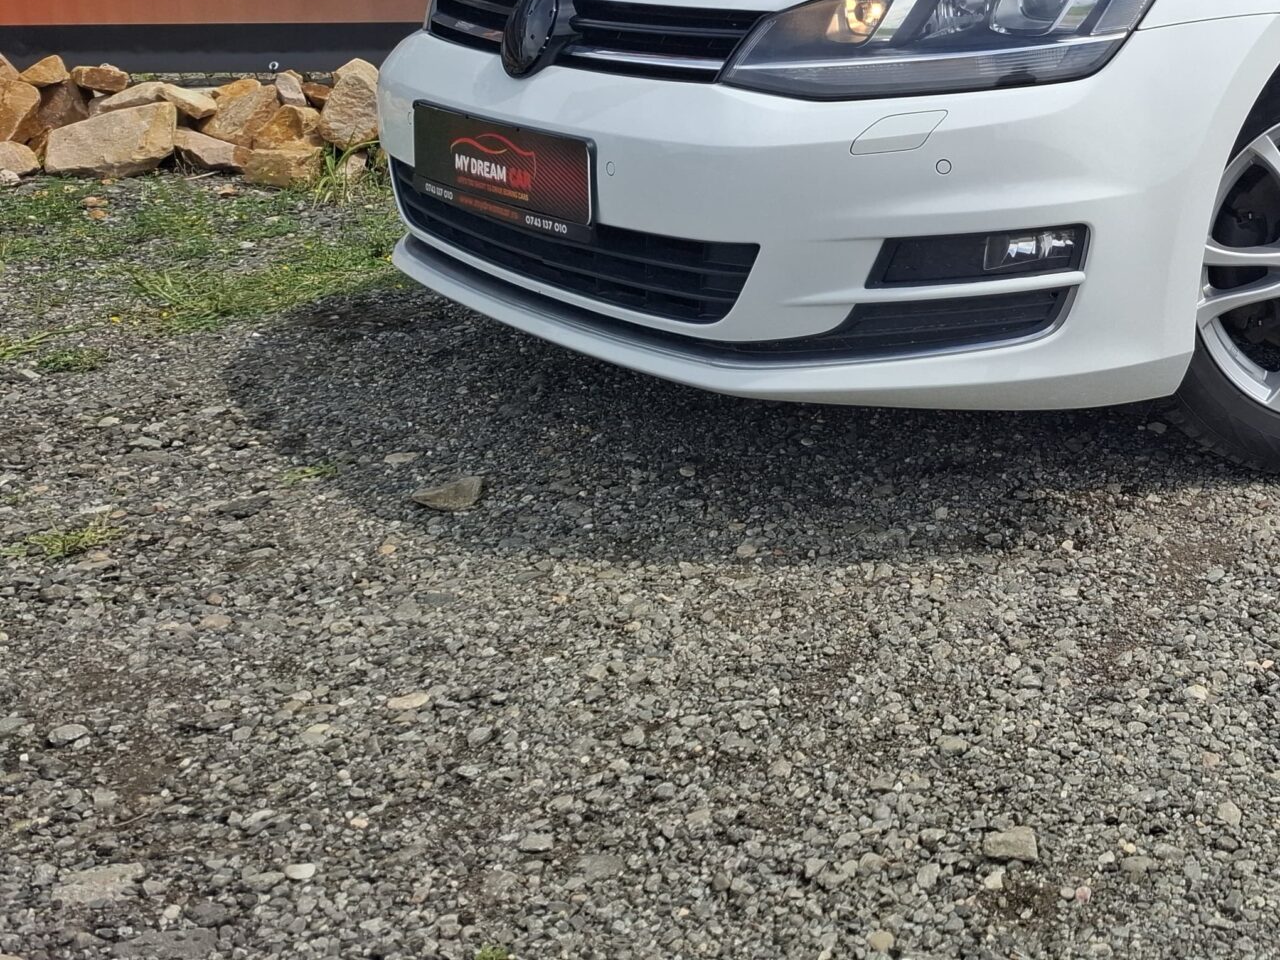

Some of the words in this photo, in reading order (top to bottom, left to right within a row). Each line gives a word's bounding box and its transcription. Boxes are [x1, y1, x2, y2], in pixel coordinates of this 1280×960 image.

[455, 153, 470, 172] MY
[470, 159, 507, 182] DREAM
[525, 215, 542, 228] 0743
[542, 218, 553, 231] 137
[553, 222, 567, 234] 010
